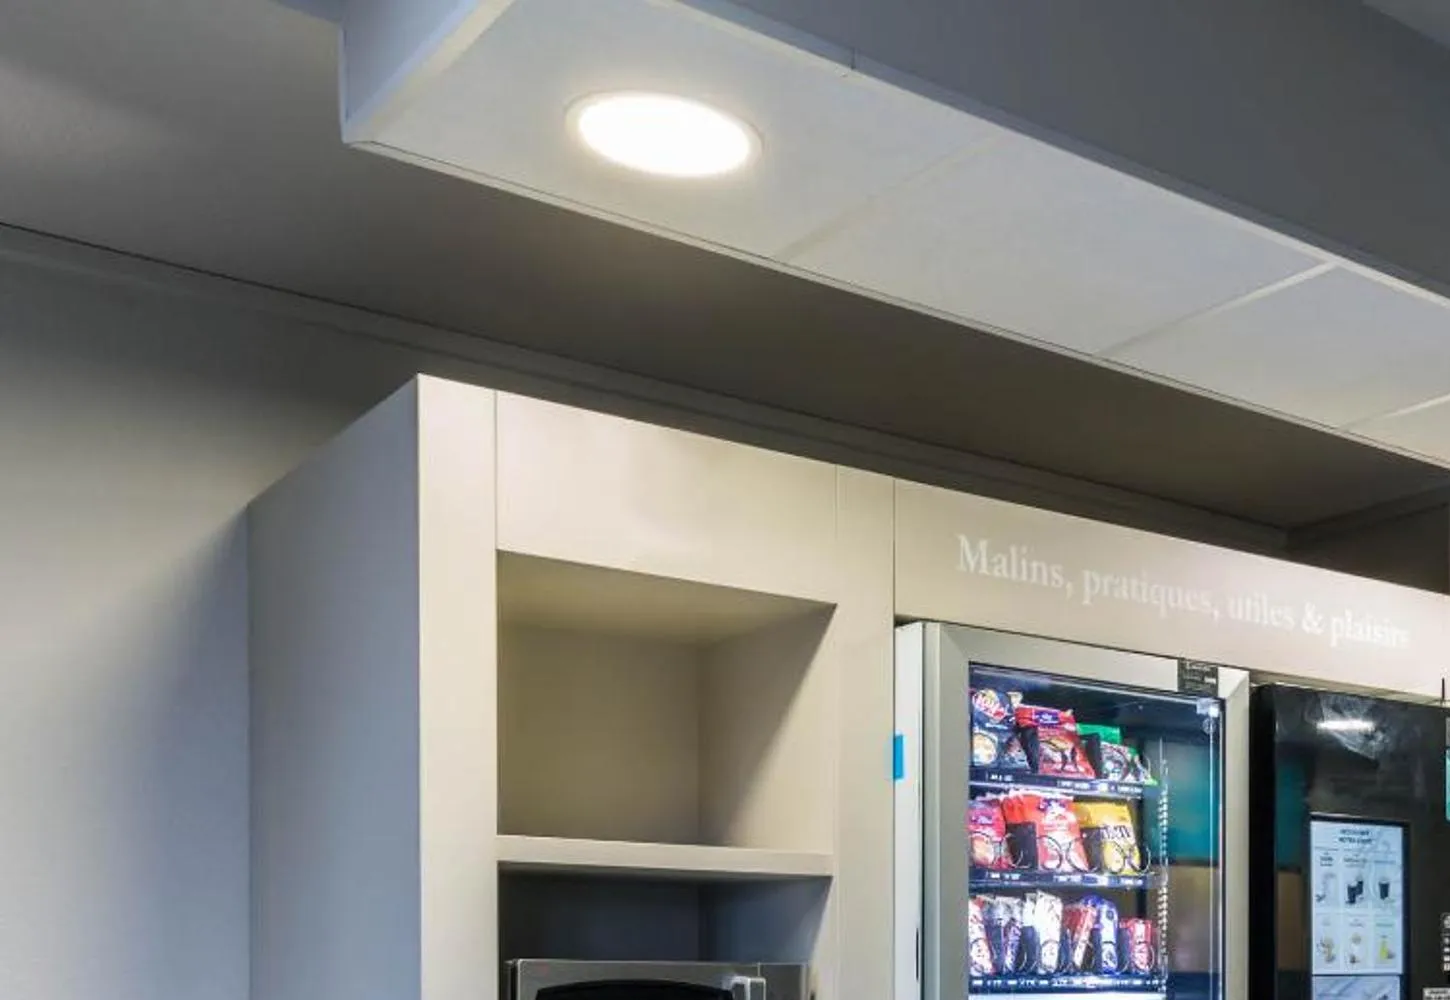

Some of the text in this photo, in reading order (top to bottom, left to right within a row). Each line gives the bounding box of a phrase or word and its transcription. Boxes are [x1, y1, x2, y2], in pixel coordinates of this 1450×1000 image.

[956, 533, 1411, 649] Malins, pratiques, utiles & plaisirs
